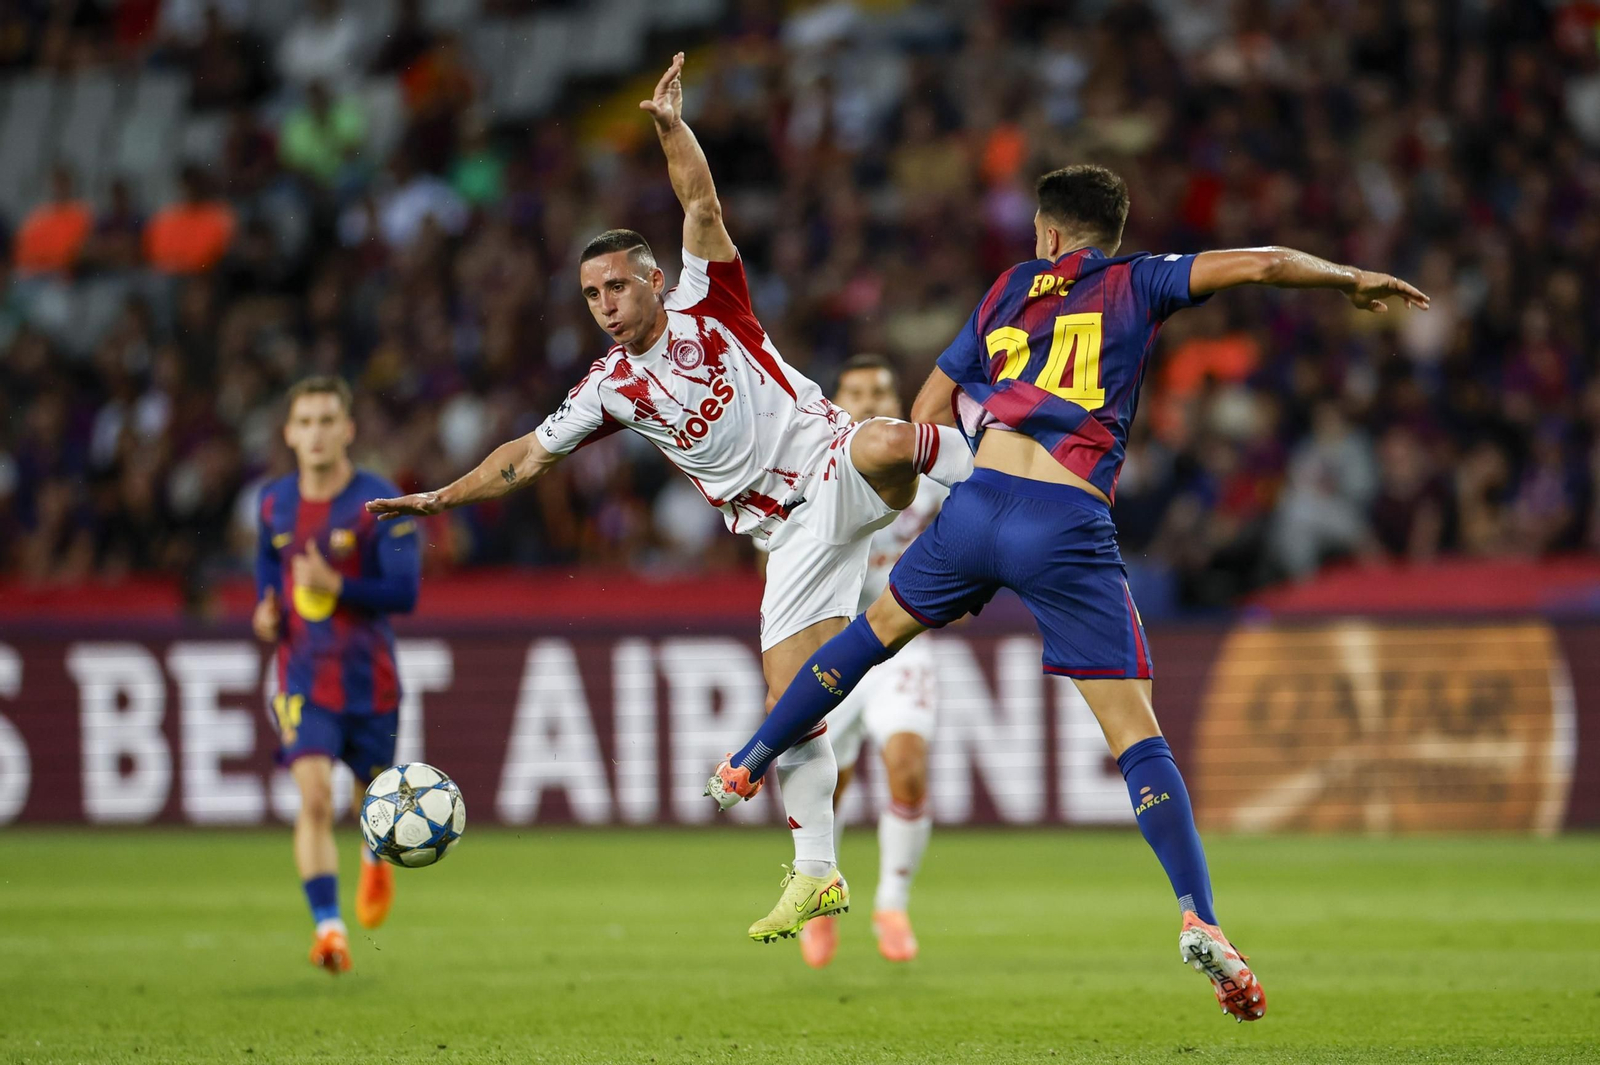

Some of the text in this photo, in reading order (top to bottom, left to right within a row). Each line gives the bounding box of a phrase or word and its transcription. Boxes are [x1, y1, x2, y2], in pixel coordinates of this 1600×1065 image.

[1028, 274, 1076, 298] ERIC
[986, 312, 1105, 412] 24
[66, 641, 453, 826] BET
[496, 637, 1137, 825] AIRNE
